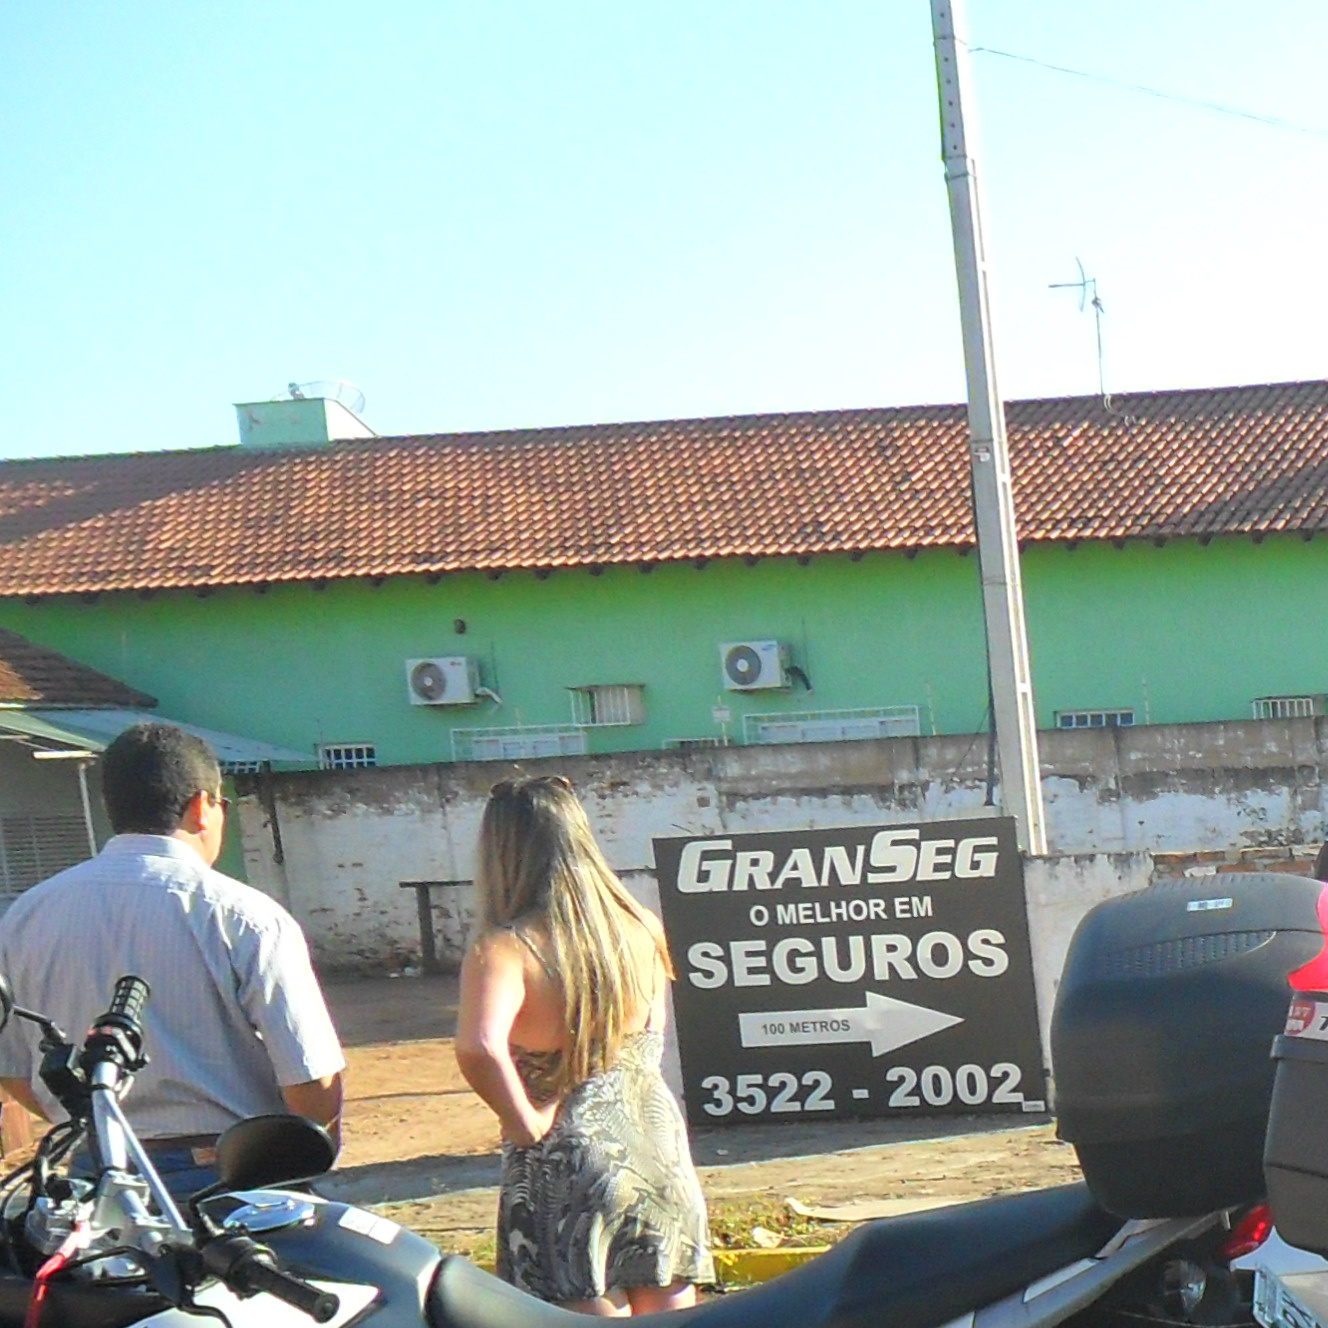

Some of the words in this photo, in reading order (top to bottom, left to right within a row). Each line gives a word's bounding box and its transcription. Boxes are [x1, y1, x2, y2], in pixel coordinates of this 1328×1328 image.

[749, 905, 769, 927] O
[777, 899, 888, 926] MELHOR
[894, 895, 933, 920] EM
[687, 929, 1009, 989] SEGUROS
[761, 1022, 786, 1036] 100
[789, 1019, 851, 1035] METROS
[701, 1071, 836, 1117] 3522
[886, 1062, 1024, 1108] 2002
